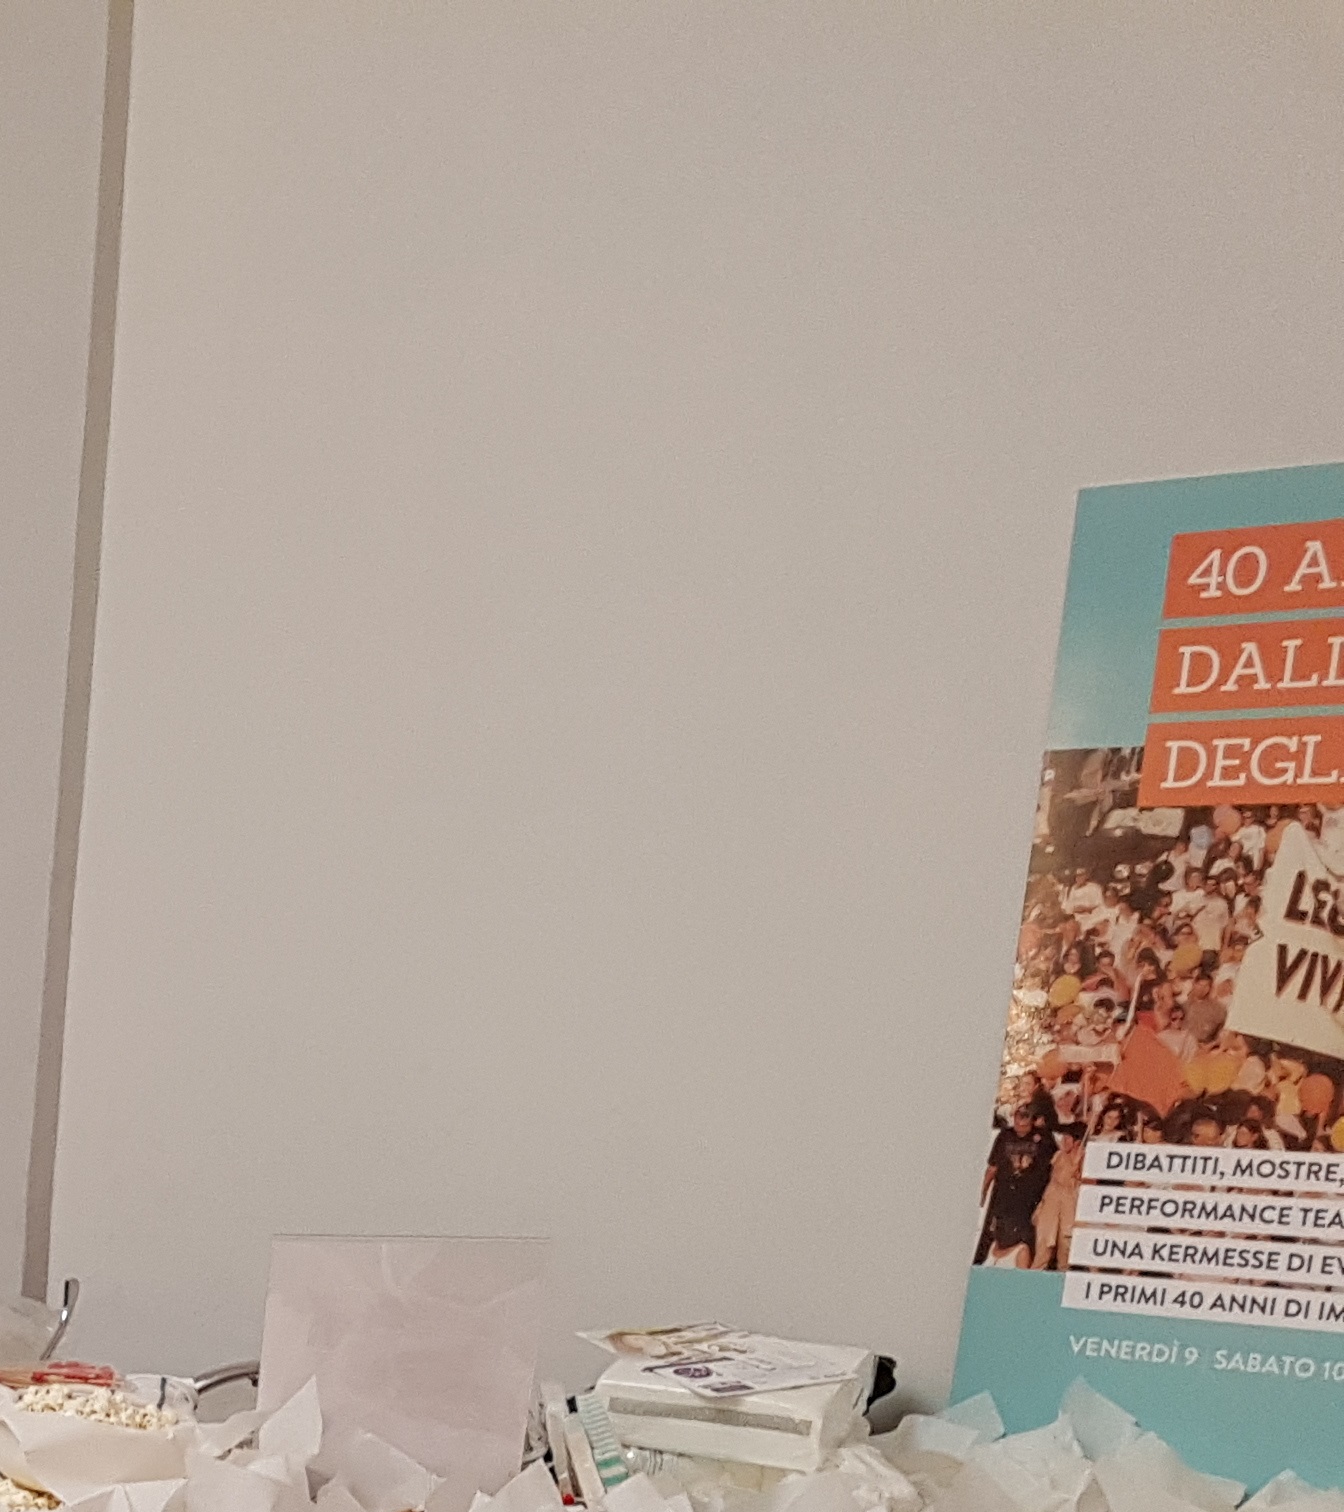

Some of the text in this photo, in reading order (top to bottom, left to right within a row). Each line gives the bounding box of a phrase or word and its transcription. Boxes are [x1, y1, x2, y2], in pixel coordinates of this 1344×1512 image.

[1186, 539, 1344, 599] 40 A
[1159, 733, 1344, 790] DEGL
[1105, 1150, 1226, 1179] DIBATTITI,
[1098, 1195, 1294, 1227] PERFORMANCE
[1091, 1238, 1144, 1261] UNA
[1151, 1243, 1280, 1271] KERMESSE
[1286, 1252, 1314, 1274] DI
[1084, 1281, 1092, 1300] I
[1098, 1283, 1168, 1307] PRIMI
[1172, 1290, 1205, 1310] 40
[1209, 1292, 1277, 1317] ANNI
[1283, 1299, 1311, 1320] DI
[1069, 1334, 1179, 1364] VENERDÌ
[1184, 1346, 1200, 1367] 9
[1213, 1349, 1316, 1379] SABATO
